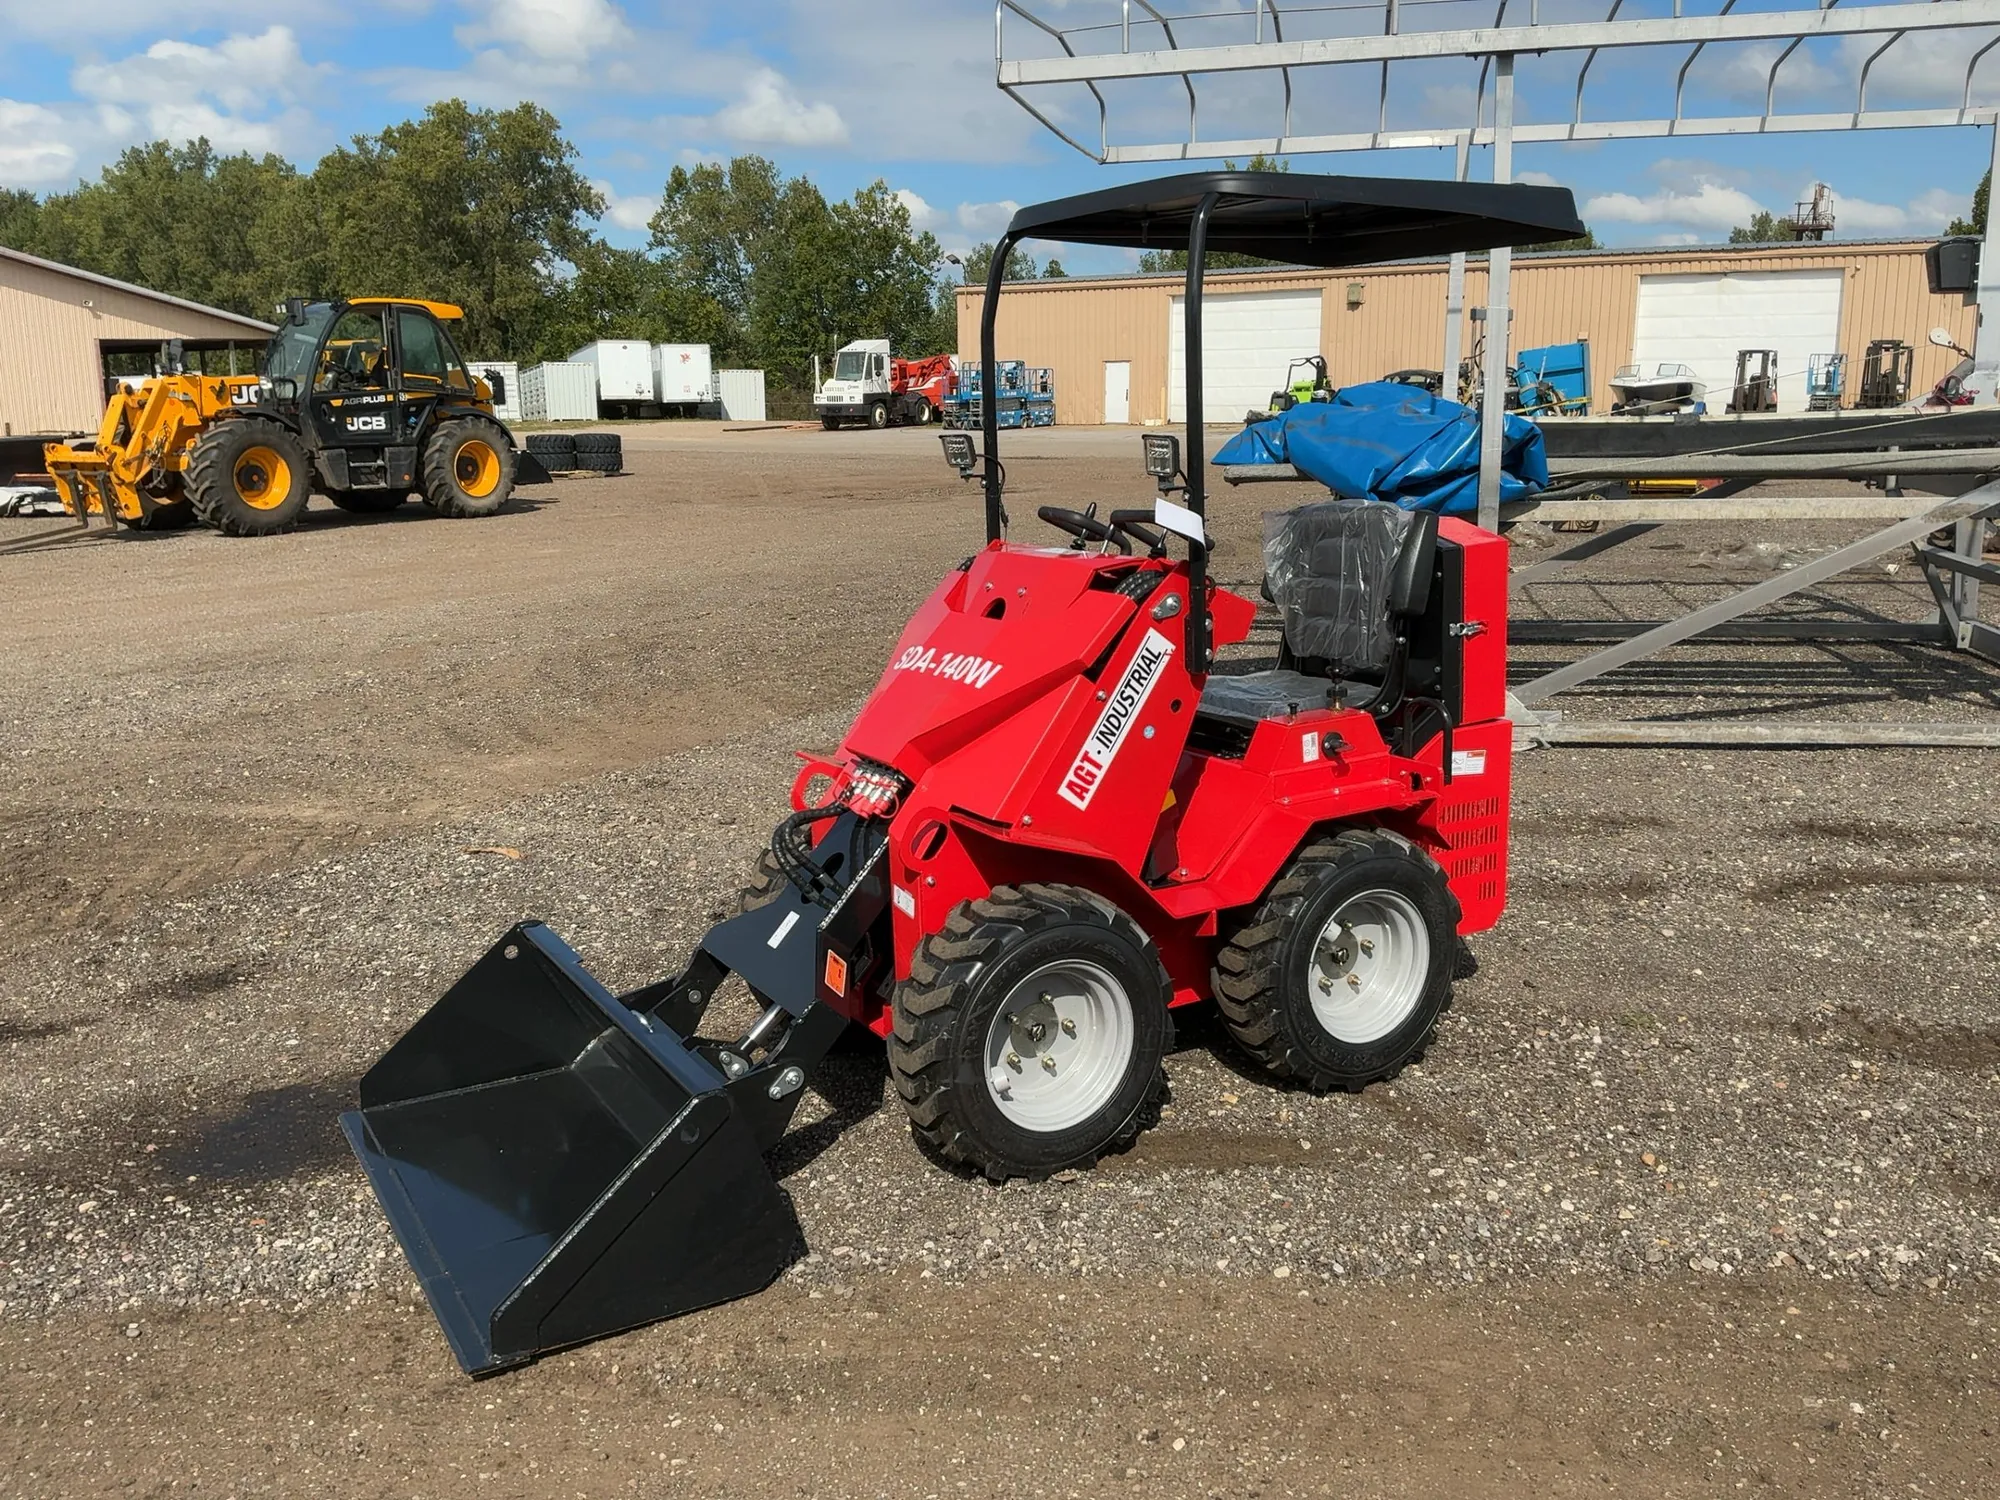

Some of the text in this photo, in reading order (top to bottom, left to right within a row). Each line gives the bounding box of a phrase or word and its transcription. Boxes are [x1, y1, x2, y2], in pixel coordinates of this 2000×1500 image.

[231, 384, 260, 405] JC
[346, 416, 386, 431] JCB
[893, 645, 1004, 689] SDA-140W
[1065, 647, 1162, 803] AGT INDUSTRIAL
